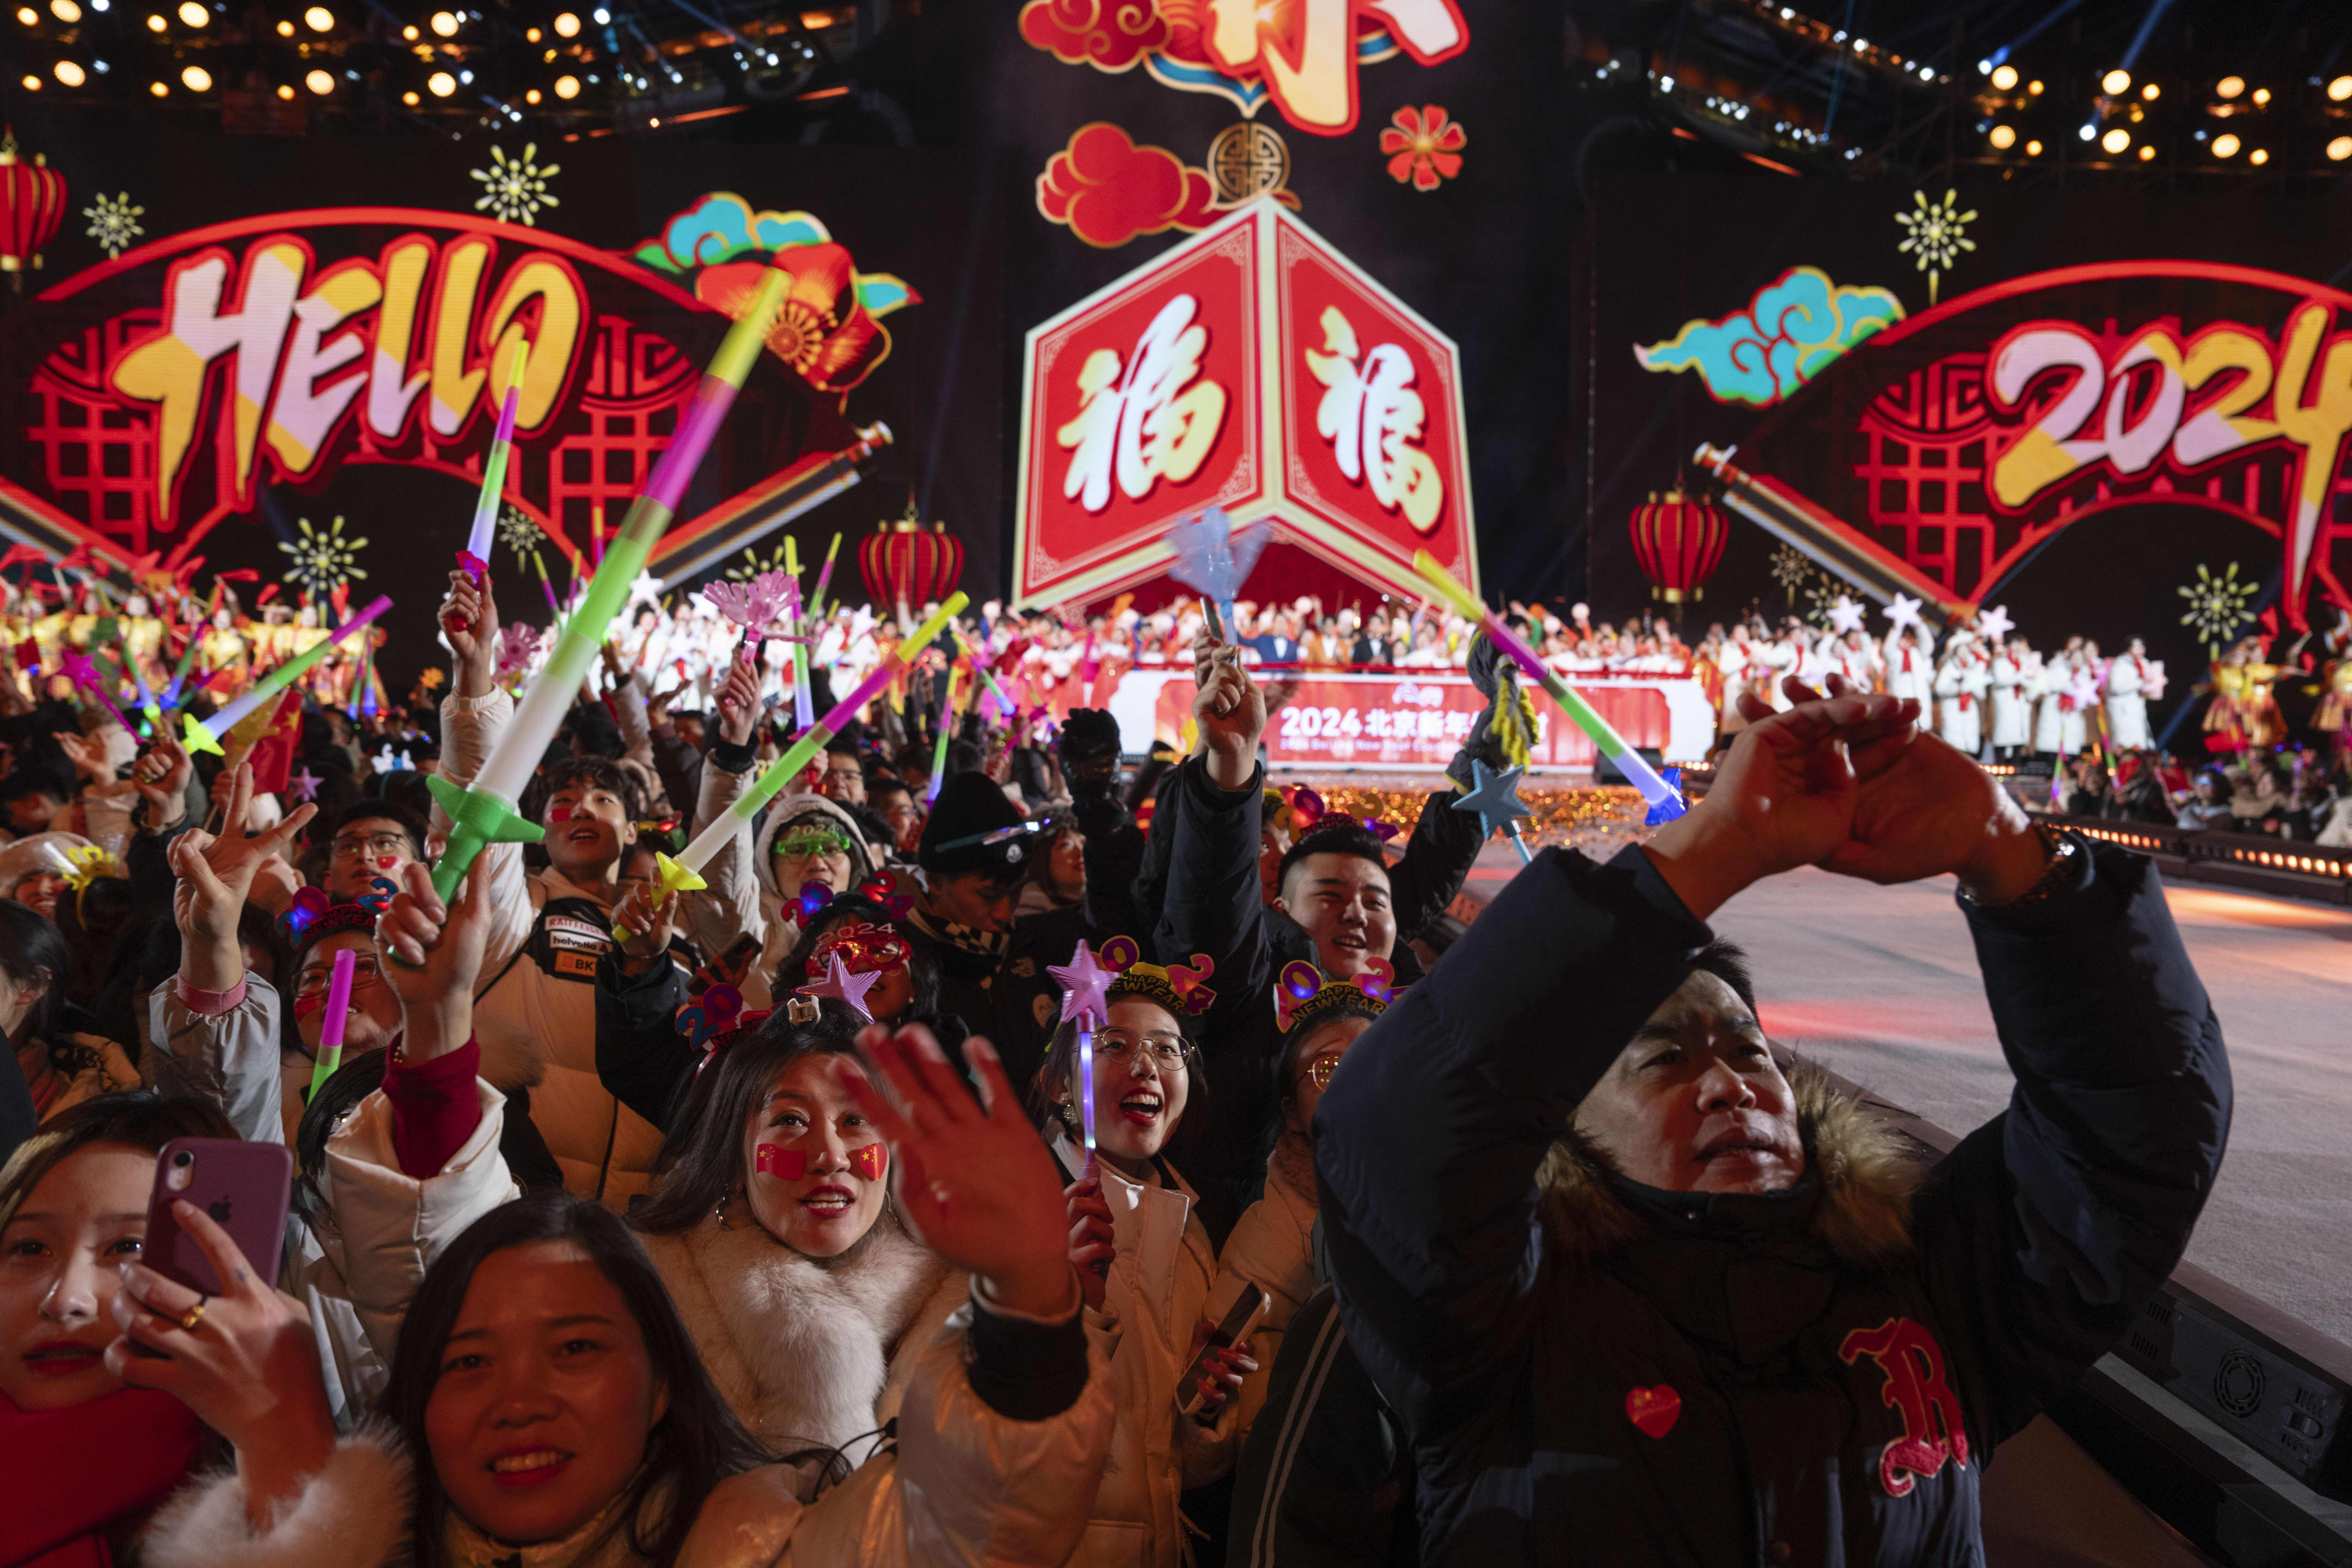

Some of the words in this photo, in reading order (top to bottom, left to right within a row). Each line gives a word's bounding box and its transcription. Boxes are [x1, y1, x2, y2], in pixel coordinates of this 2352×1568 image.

[113, 242, 579, 522] HELLO
[1058, 294, 1226, 511] 福
[1306, 306, 1443, 532] 福
[1994, 305, 2352, 593] 2024
[1281, 706, 1363, 737] 2024
[275, 876, 399, 951] 202
[553, 936, 597, 951] helvetia
[575, 959, 595, 971] BK
[1091, 935, 1217, 1016] 024
[1129, 975, 1169, 989] HAPPY
[1318, 986, 1359, 1000] HAPPY
